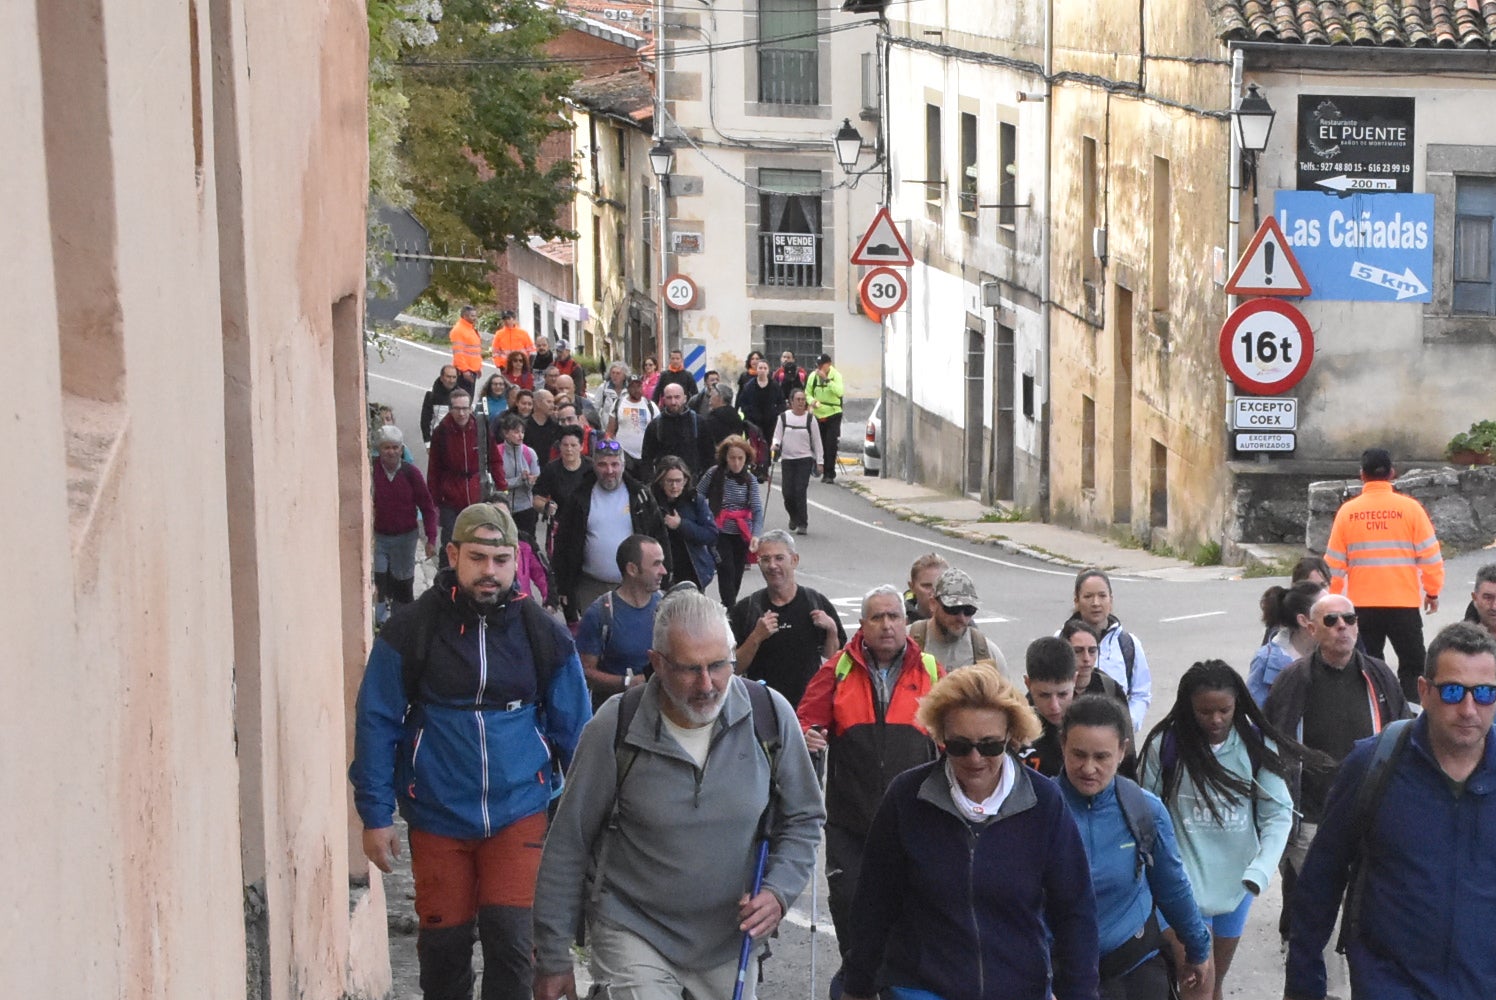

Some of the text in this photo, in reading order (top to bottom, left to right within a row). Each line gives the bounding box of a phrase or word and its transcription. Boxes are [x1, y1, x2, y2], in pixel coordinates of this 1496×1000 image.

[1320, 118, 1357, 126] Restaurante
[1320, 126, 1406, 140] EL PUENTE
[1300, 162, 1320, 171] Telfs.:
[1320, 162, 1332, 171] 927
[1334, 163, 1343, 171] 48
[1344, 163, 1352, 171] 80
[1354, 163, 1362, 171] 15
[1368, 164, 1380, 172] 616
[1382, 164, 1390, 172] 23
[1391, 164, 1400, 173] 99
[1402, 164, 1410, 173] 19
[1351, 180, 1373, 188] 200
[1280, 209, 1428, 250] Las Cañadas
[775, 236, 813, 246] SE VENDE
[1357, 267, 1419, 294] 5 km
[671, 285, 689, 299] 20
[871, 283, 897, 299] 30
[1240, 331, 1292, 363] 16t
[1240, 402, 1292, 412] EXCEPTO
[1250, 415, 1281, 425] COEX
[1349, 510, 1403, 521] PROTECCION
[1366, 521, 1389, 530] CIVIL
